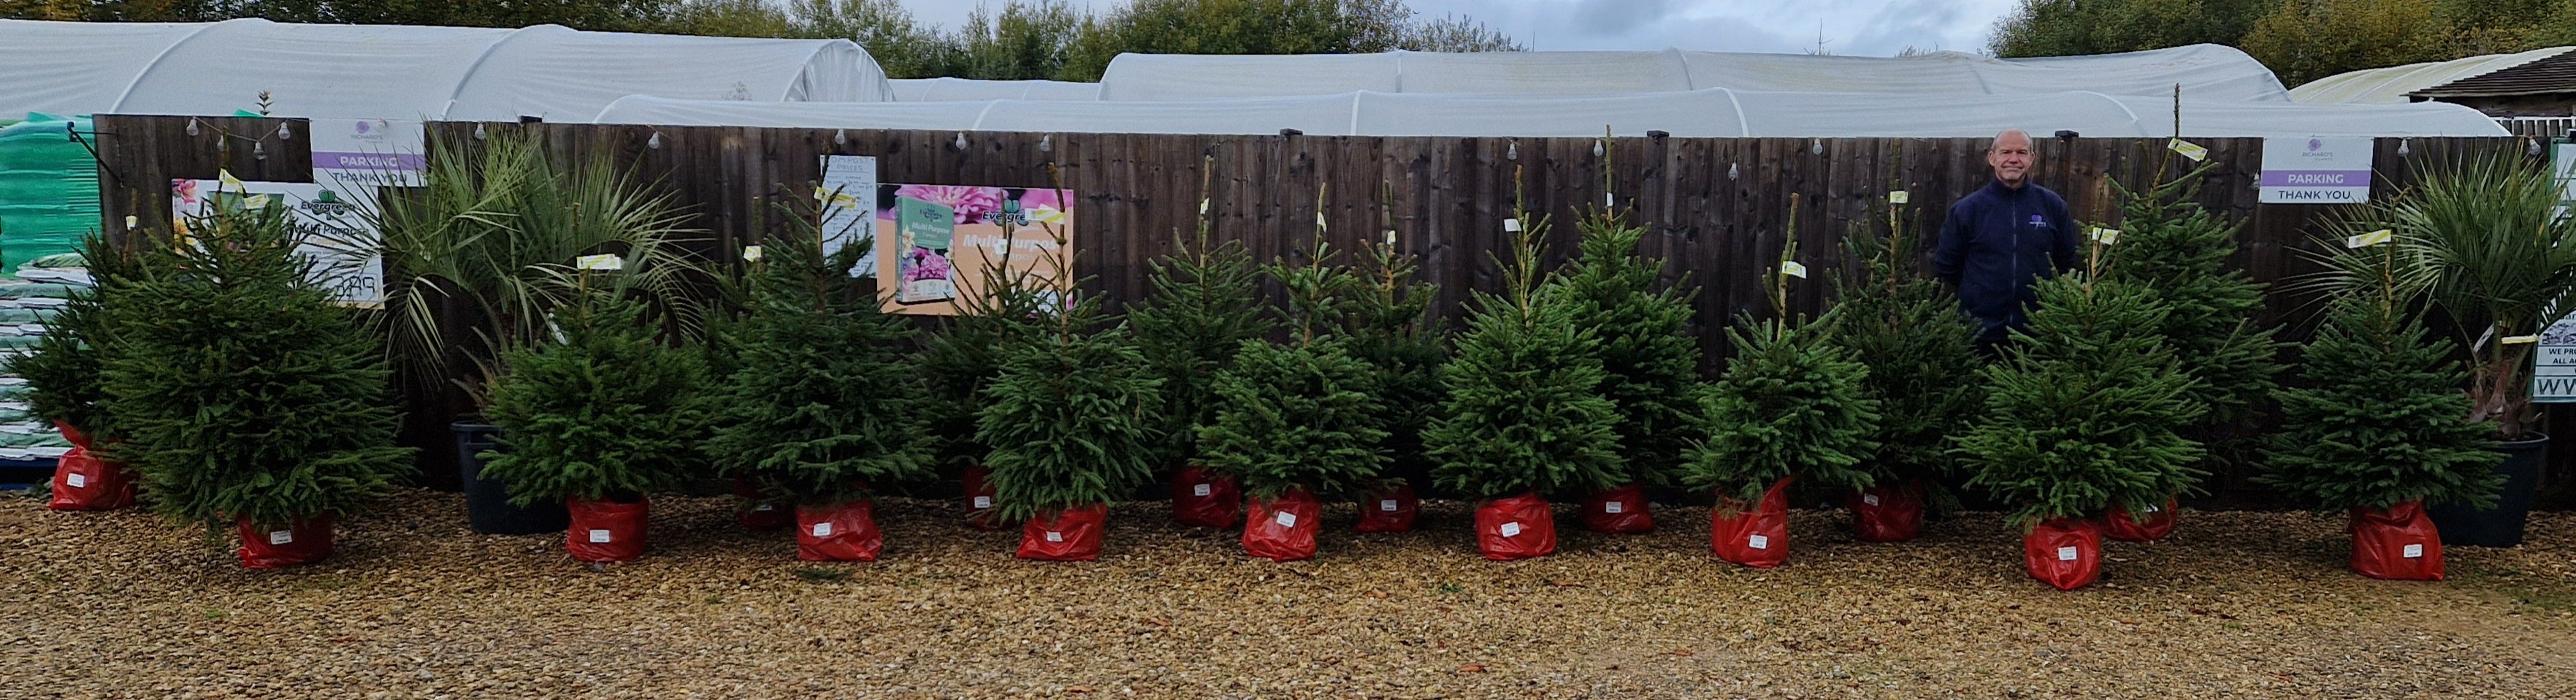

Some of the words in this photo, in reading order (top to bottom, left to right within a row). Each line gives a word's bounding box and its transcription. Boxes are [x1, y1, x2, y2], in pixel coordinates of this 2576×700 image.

[340, 156, 399, 167] PARKING
[332, 172, 378, 183] THANK
[381, 173, 408, 183] YOU
[2288, 174, 2344, 183] PARKING
[2278, 190, 2321, 199] THANK
[2325, 190, 2351, 199] YOU
[1009, 237, 1060, 252] urpos
